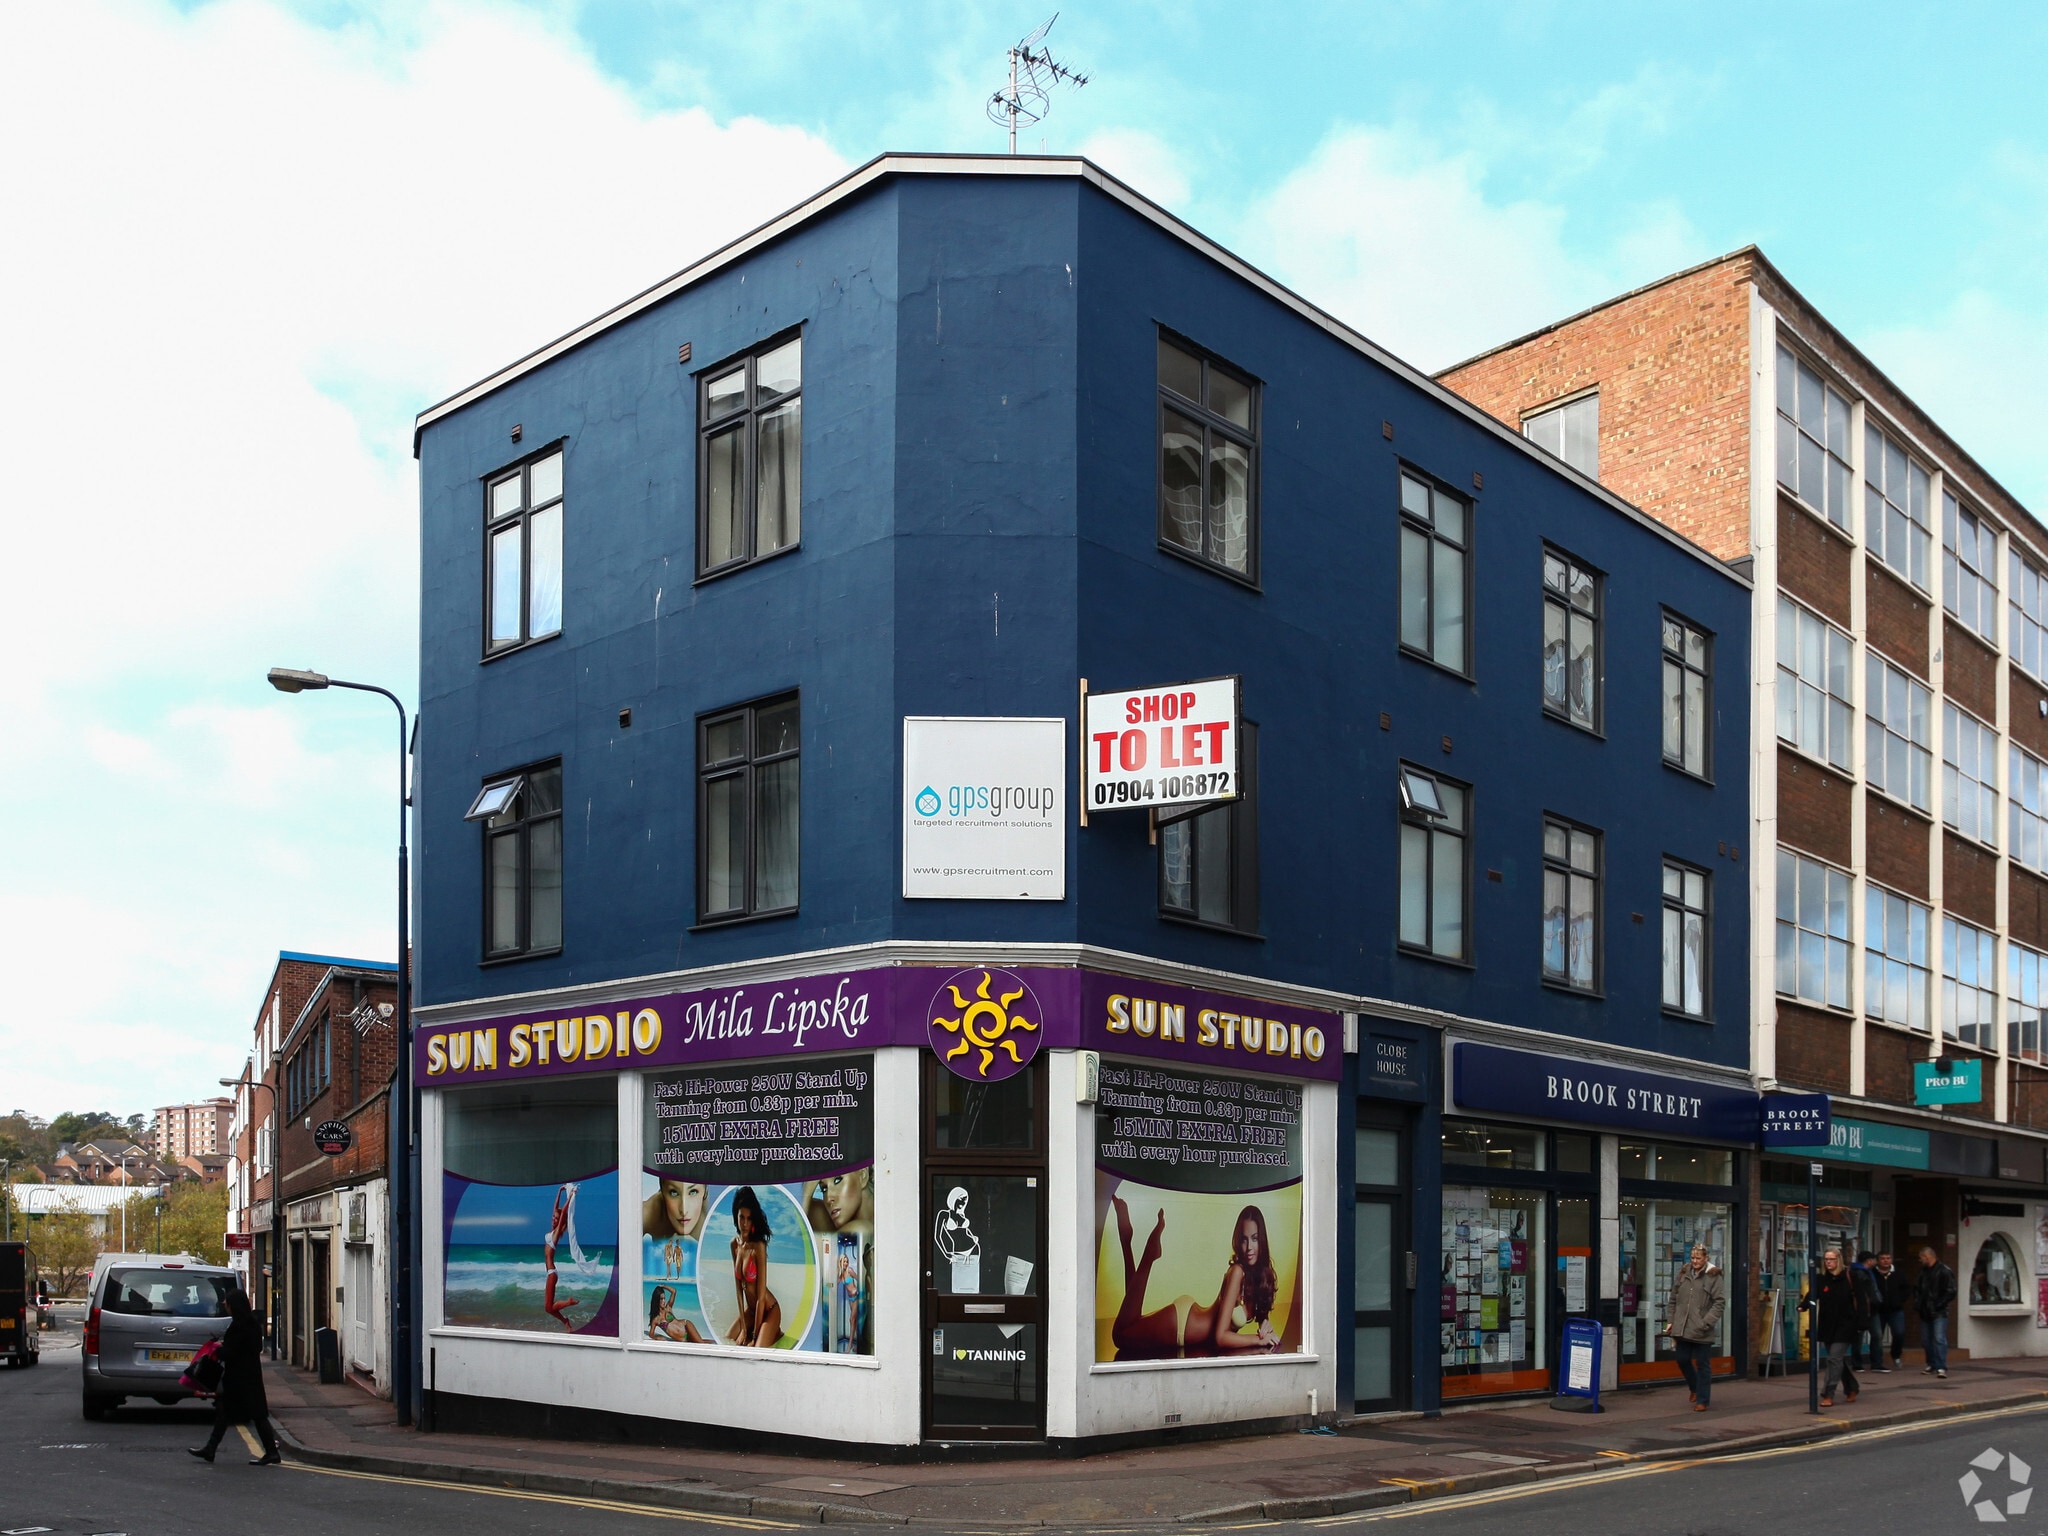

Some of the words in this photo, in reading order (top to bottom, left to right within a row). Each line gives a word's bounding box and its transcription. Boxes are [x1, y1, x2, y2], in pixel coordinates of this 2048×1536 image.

[1125, 692, 1196, 724] SHOP
[1093, 728, 1147, 773] TO
[1160, 721, 1230, 769] LET
[948, 785, 1054, 818] gpsgroup
[1094, 779, 1154, 805] 07904
[1159, 772, 1229, 799] 106872
[913, 819, 953, 828] targeted
[955, 819, 1008, 828] recruitment
[1010, 820, 1053, 828] solutions
[912, 866, 1054, 877] www.gpsrecruitment.com
[684, 990, 753, 1044] Mila
[761, 977, 869, 1047] Lipska
[427, 1027, 497, 1076] SUN
[509, 1007, 663, 1067] STUDIO
[1106, 993, 1185, 1043] SUN
[1197, 1009, 1326, 1062] STUDIO
[1376, 1042, 1407, 1060] GLOBE
[1376, 1060, 1407, 1076] HOUSE
[1925, 1077, 1950, 1087] PRO
[1952, 1075, 1969, 1086] BU
[653, 1081, 682, 1098] Fast
[685, 1078, 749, 1095] Hi-Power
[751, 1073, 792, 1092] 250W
[796, 1070, 841, 1089] Stand
[845, 1068, 868, 1091] Up
[1133, 1070, 1200, 1095] Hi-Power
[1203, 1080, 1241, 1098] 250W
[1244, 1084, 1282, 1105] Stand
[1285, 1089, 1303, 1110] Up
[655, 1101, 711, 1119] Tanning
[713, 1098, 747, 1114] from
[750, 1095, 791, 1114] 0.33p
[794, 1095, 819, 1112] per
[822, 1090, 858, 1108] min.
[1101, 1089, 1164, 1114] Tanning
[1167, 1095, 1201, 1114] from
[1204, 1100, 1243, 1121] 0.33p
[1245, 1109, 1267, 1123] per
[1270, 1110, 1298, 1125] min.
[1547, 1075, 1618, 1107] BROOK
[1627, 1088, 1703, 1120] STREET
[1762, 1121, 1824, 1131] STREET
[1768, 1110, 1820, 1119] BROOK
[316, 1122, 349, 1136] SAPPHIRE
[663, 1121, 716, 1144] 15MIN
[720, 1118, 782, 1140] EXTRA
[785, 1116, 839, 1138] FREE
[1114, 1117, 1173, 1139] 15MIN
[1176, 1120, 1238, 1143] EXTRA
[1240, 1125, 1286, 1147] FREE
[1830, 1124, 1847, 1146] RO
[1850, 1126, 1864, 1149] BU
[654, 1147, 684, 1164] with
[761, 1143, 844, 1165] purchased.
[1101, 1140, 1137, 1159] with
[1139, 1146, 1180, 1165] every
[1182, 1145, 1217, 1163] hour
[1219, 1149, 1291, 1168] purchased.
[151, 1352, 171, 1360] EF12
